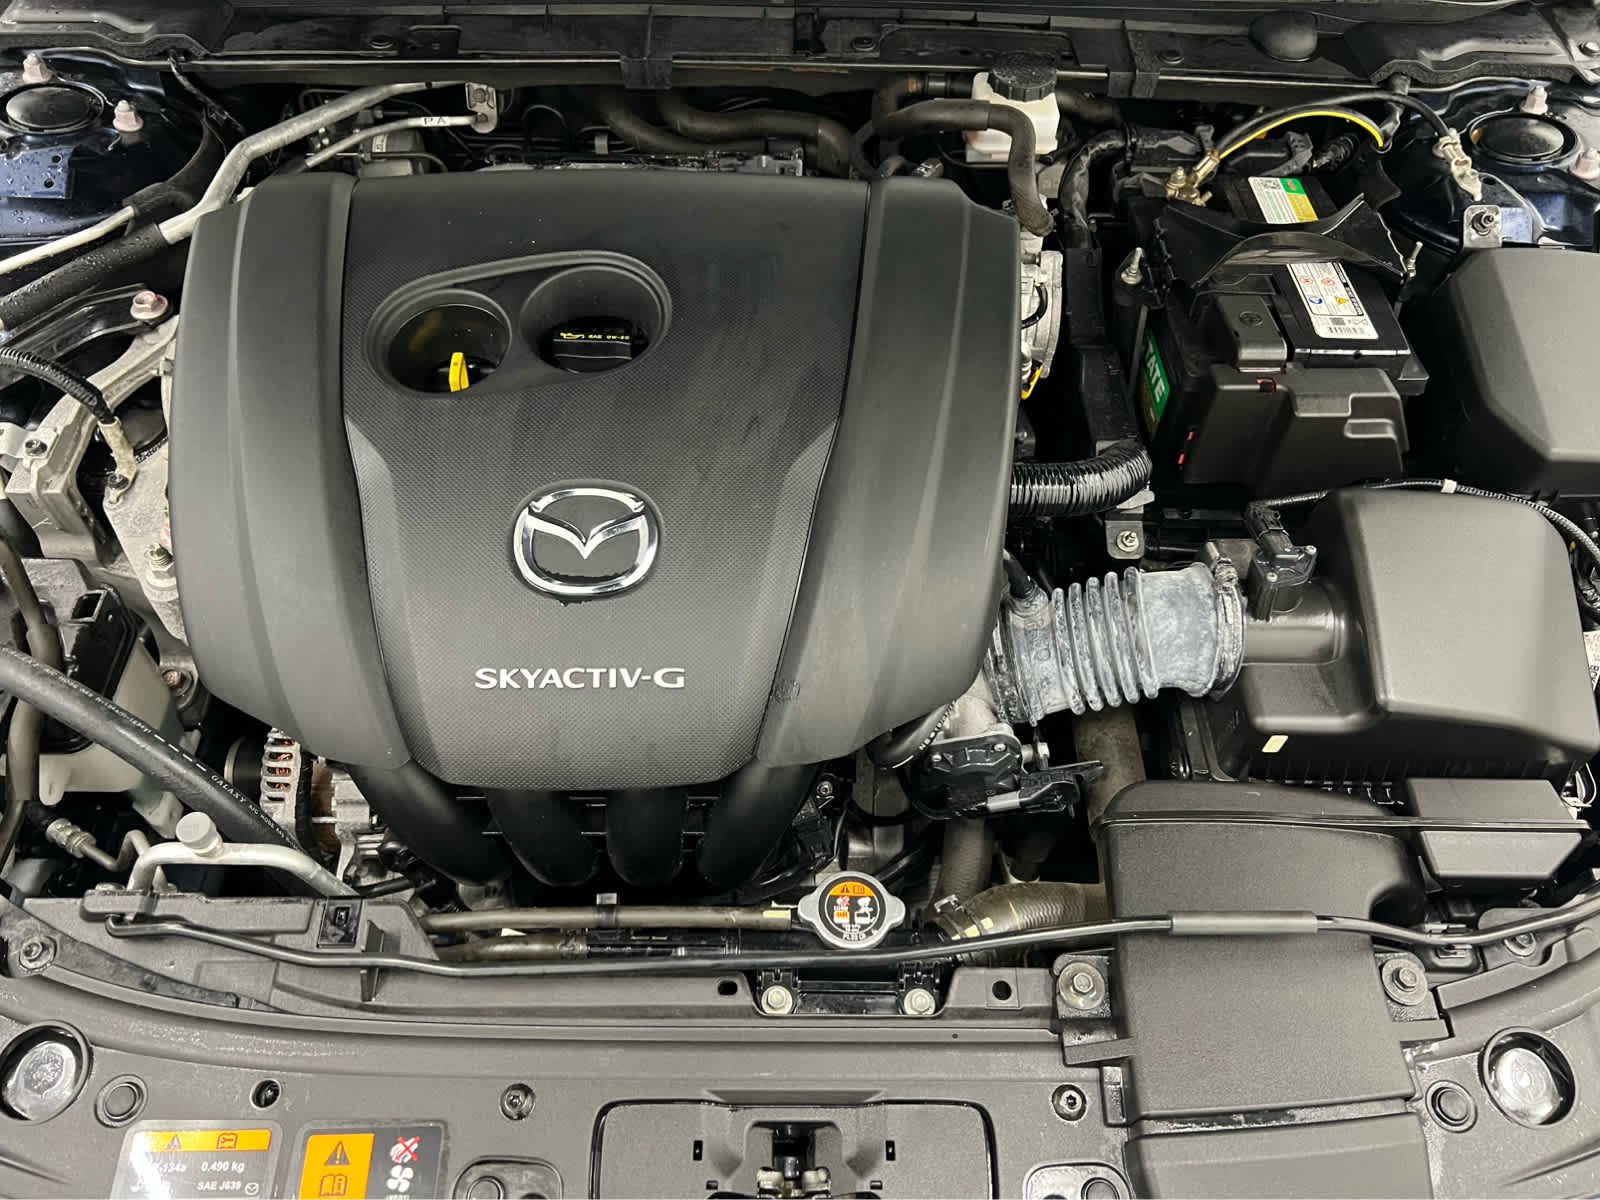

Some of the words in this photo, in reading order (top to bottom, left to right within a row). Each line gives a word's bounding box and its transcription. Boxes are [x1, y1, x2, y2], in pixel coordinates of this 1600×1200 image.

[474, 667, 686, 690] SKYACTIV-G
[211, 774, 247, 803] GALAXY
[201, 1160, 230, 1173] 0.490
[231, 1159, 246, 1175] kg
[197, 1181, 217, 1192] SAE
[219, 1180, 242, 1192] J639
